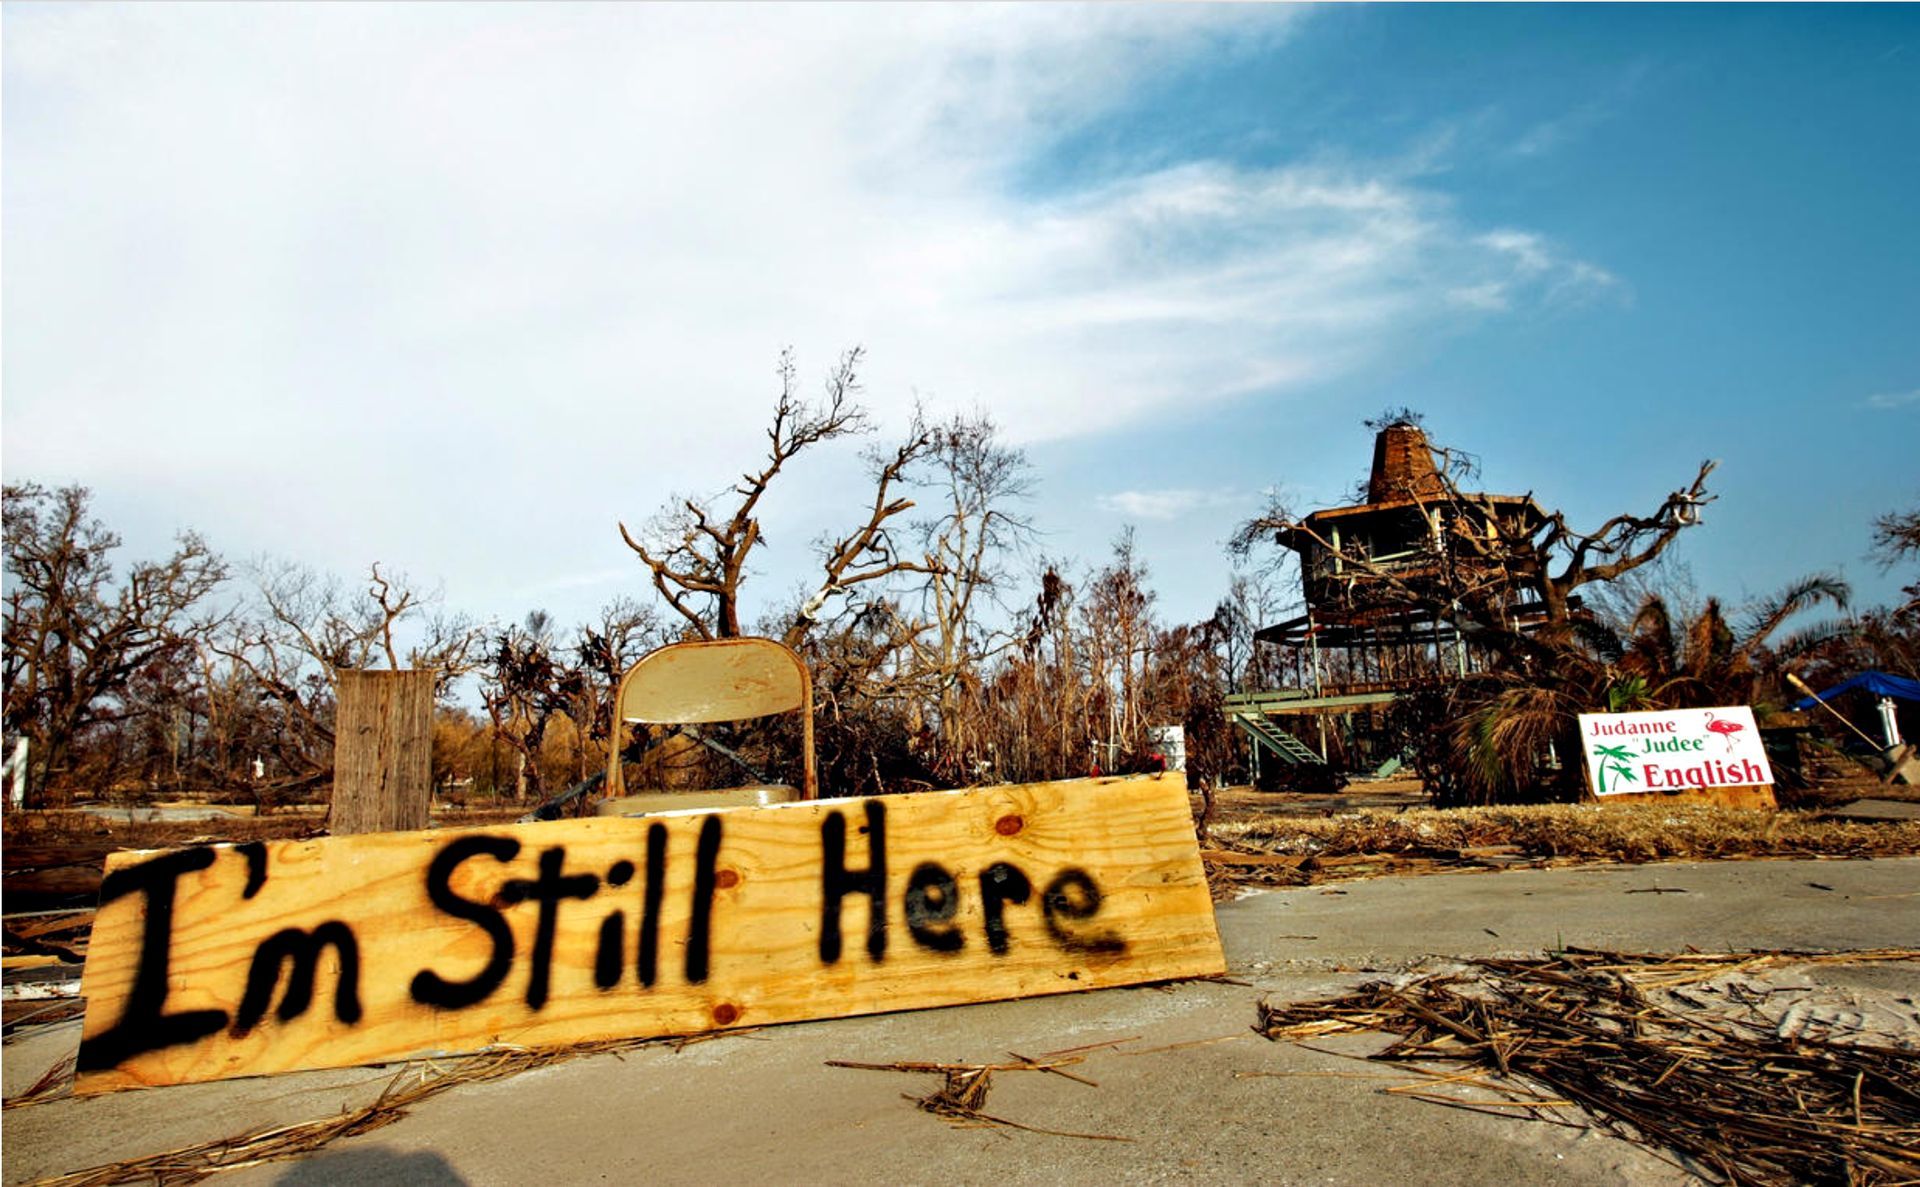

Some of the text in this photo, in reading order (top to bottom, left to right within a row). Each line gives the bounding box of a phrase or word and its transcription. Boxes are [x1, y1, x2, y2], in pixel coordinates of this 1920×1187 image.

[1590, 720, 1677, 736] Judanne
[1632, 734, 1710, 754] "Judee"
[1643, 758, 1765, 788] English
[76, 799, 1127, 1072] I'm Still Here
